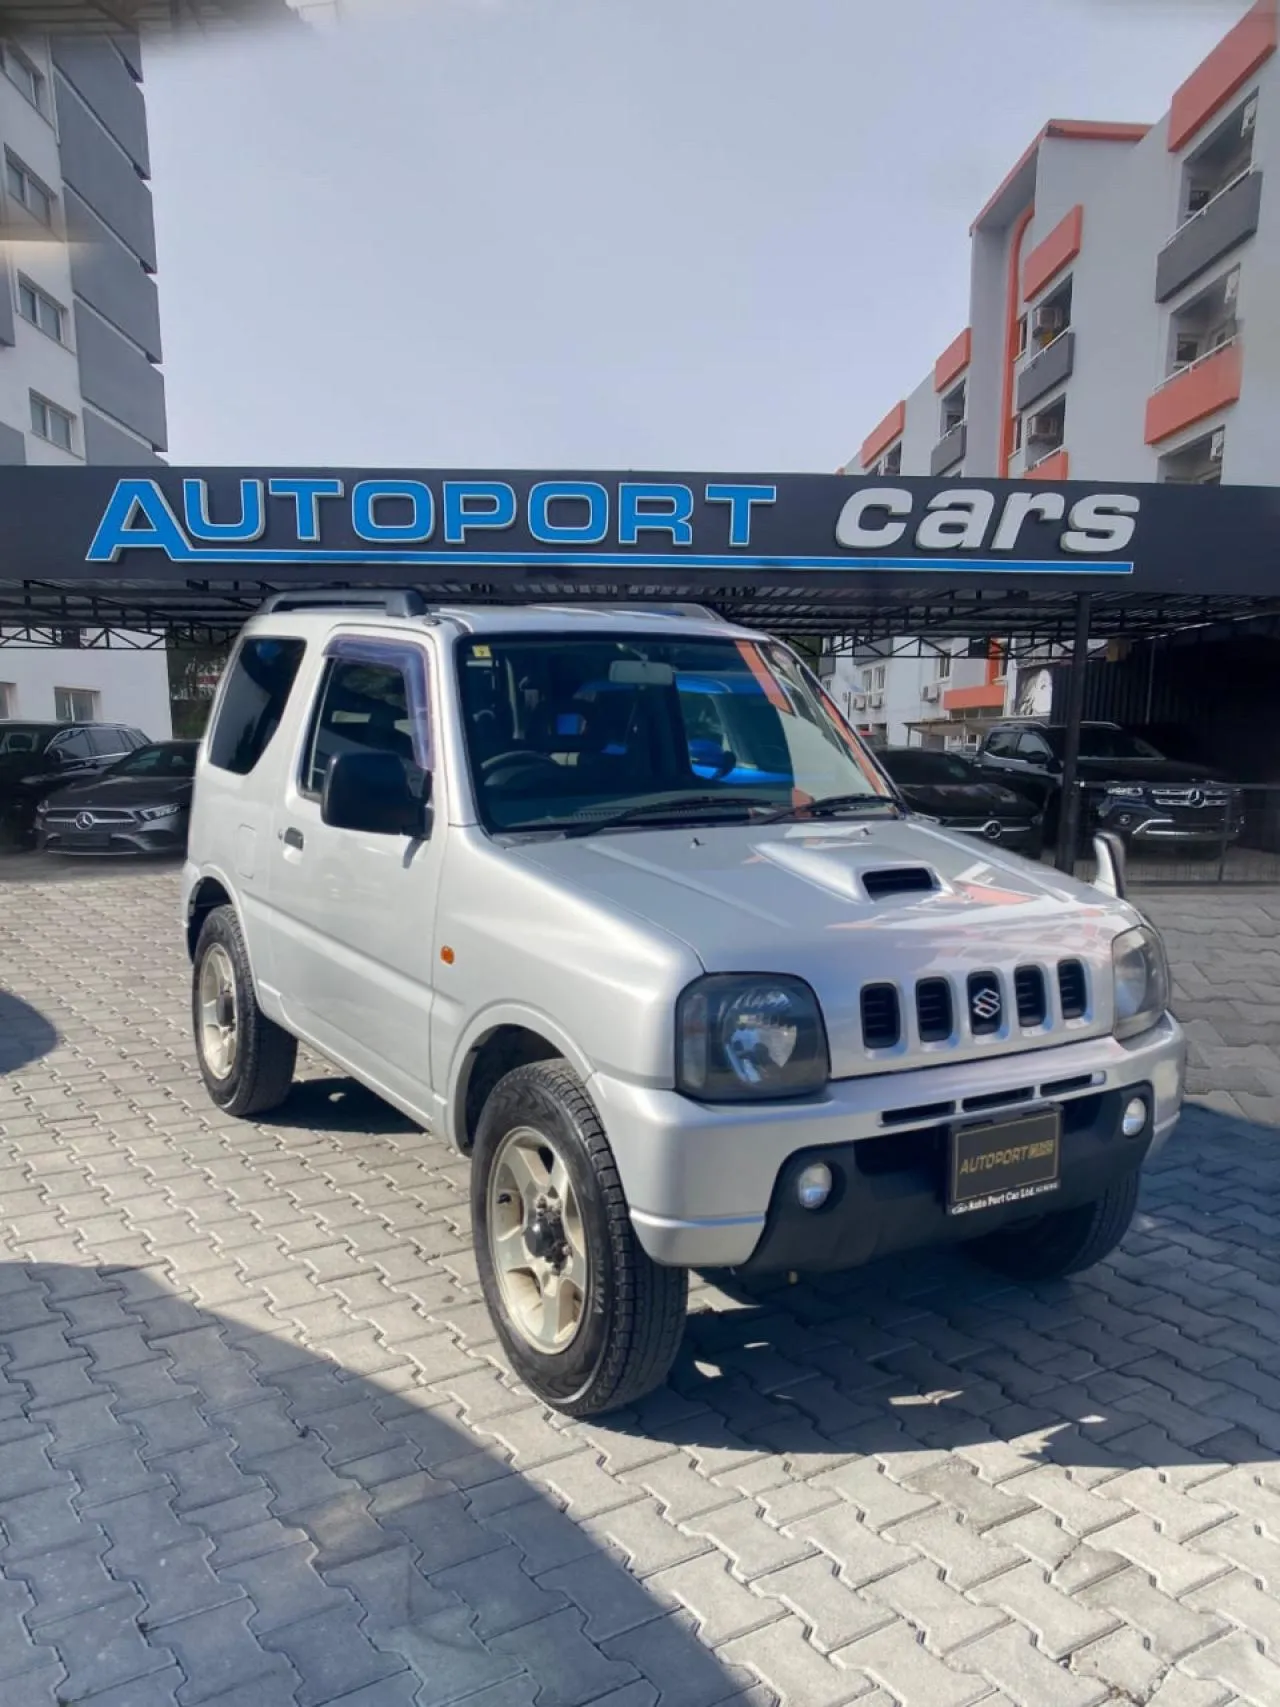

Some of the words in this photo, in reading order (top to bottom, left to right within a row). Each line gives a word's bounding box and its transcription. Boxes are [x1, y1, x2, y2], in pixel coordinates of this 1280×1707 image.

[85, 478, 777, 562] AUTOPORT
[835, 487, 1141, 552] cars
[959, 1146, 1029, 1174] AUTOPORT
